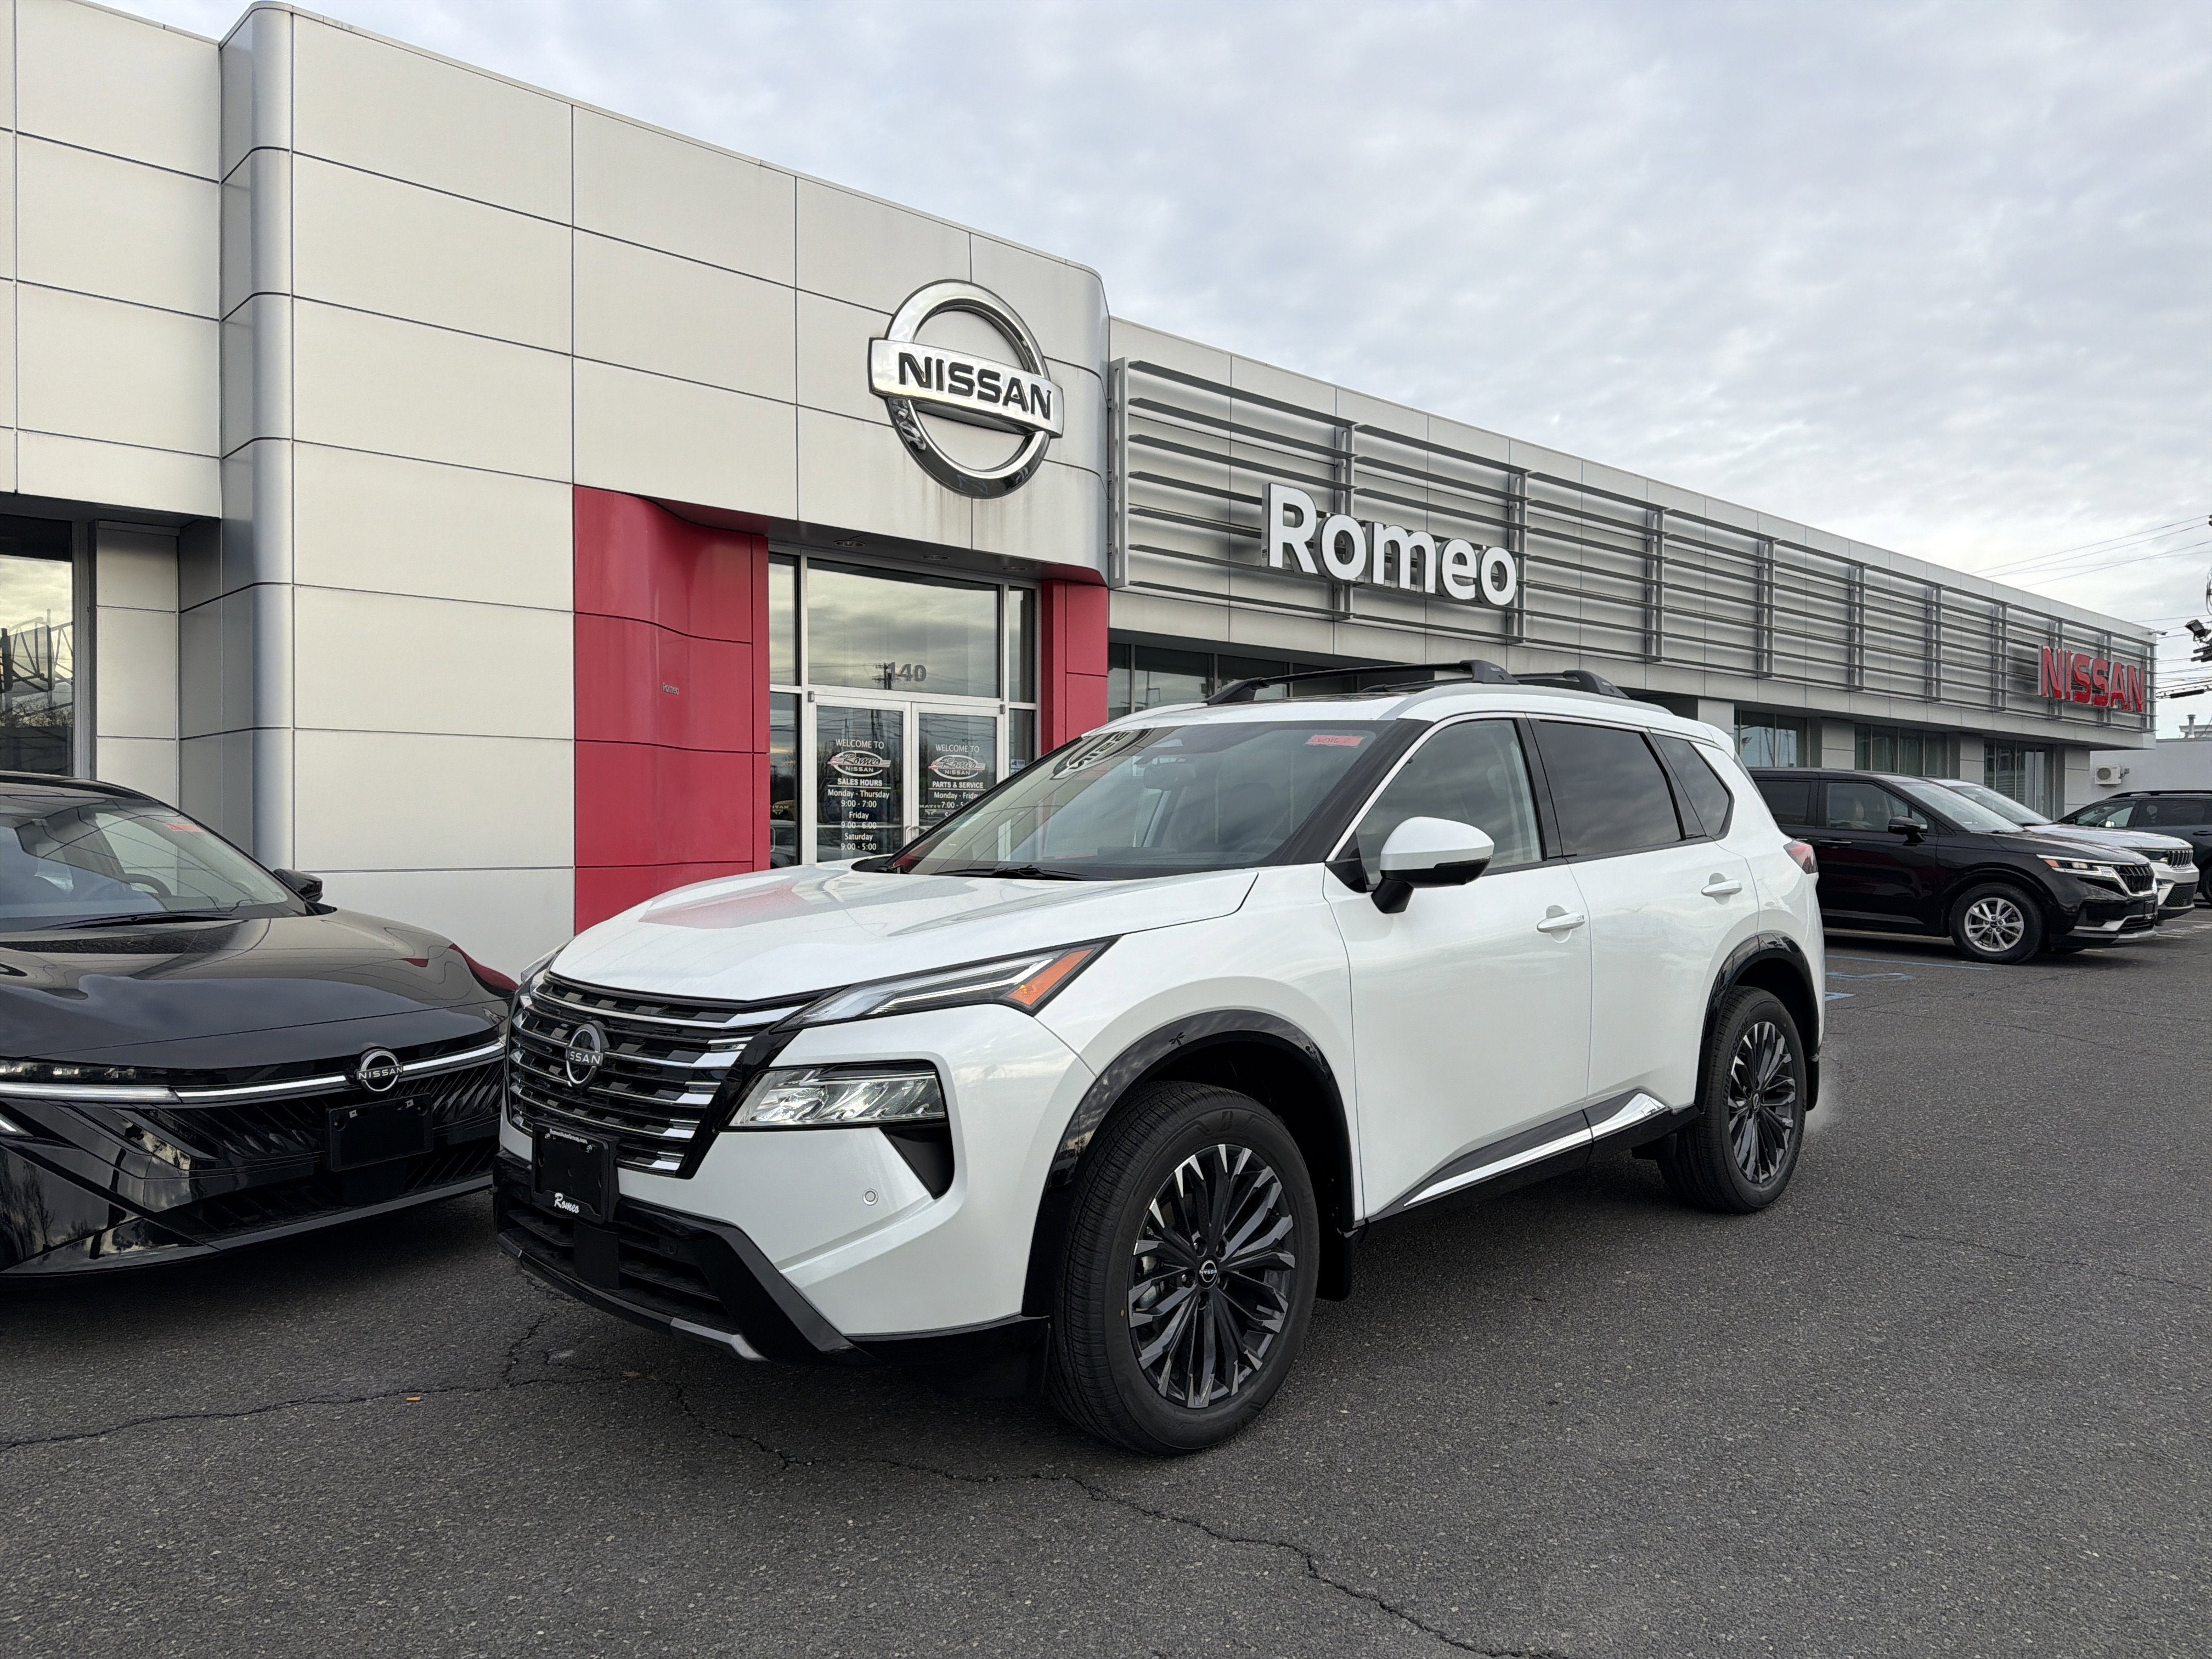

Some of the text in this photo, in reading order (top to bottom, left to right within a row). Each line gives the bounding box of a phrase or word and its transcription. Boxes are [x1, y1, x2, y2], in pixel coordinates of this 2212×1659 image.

[898, 352, 1052, 420] NISSAN
[1262, 482, 1517, 606] Romeo
[888, 662, 927, 682] 140
[2038, 645, 2146, 713] NISSAN
[836, 738, 884, 749] WELCOME TO
[935, 744, 969, 753] WELCOME
[839, 752, 881, 765] Romeo
[828, 789, 854, 799] Monday
[860, 790, 889, 799] Thursday
[934, 792, 958, 800] Monday
[849, 811, 870, 820] Friday
[844, 832, 873, 842] Saturday
[358, 1066, 403, 1079] NISSAN
[554, 1193, 579, 1214] Romeo
